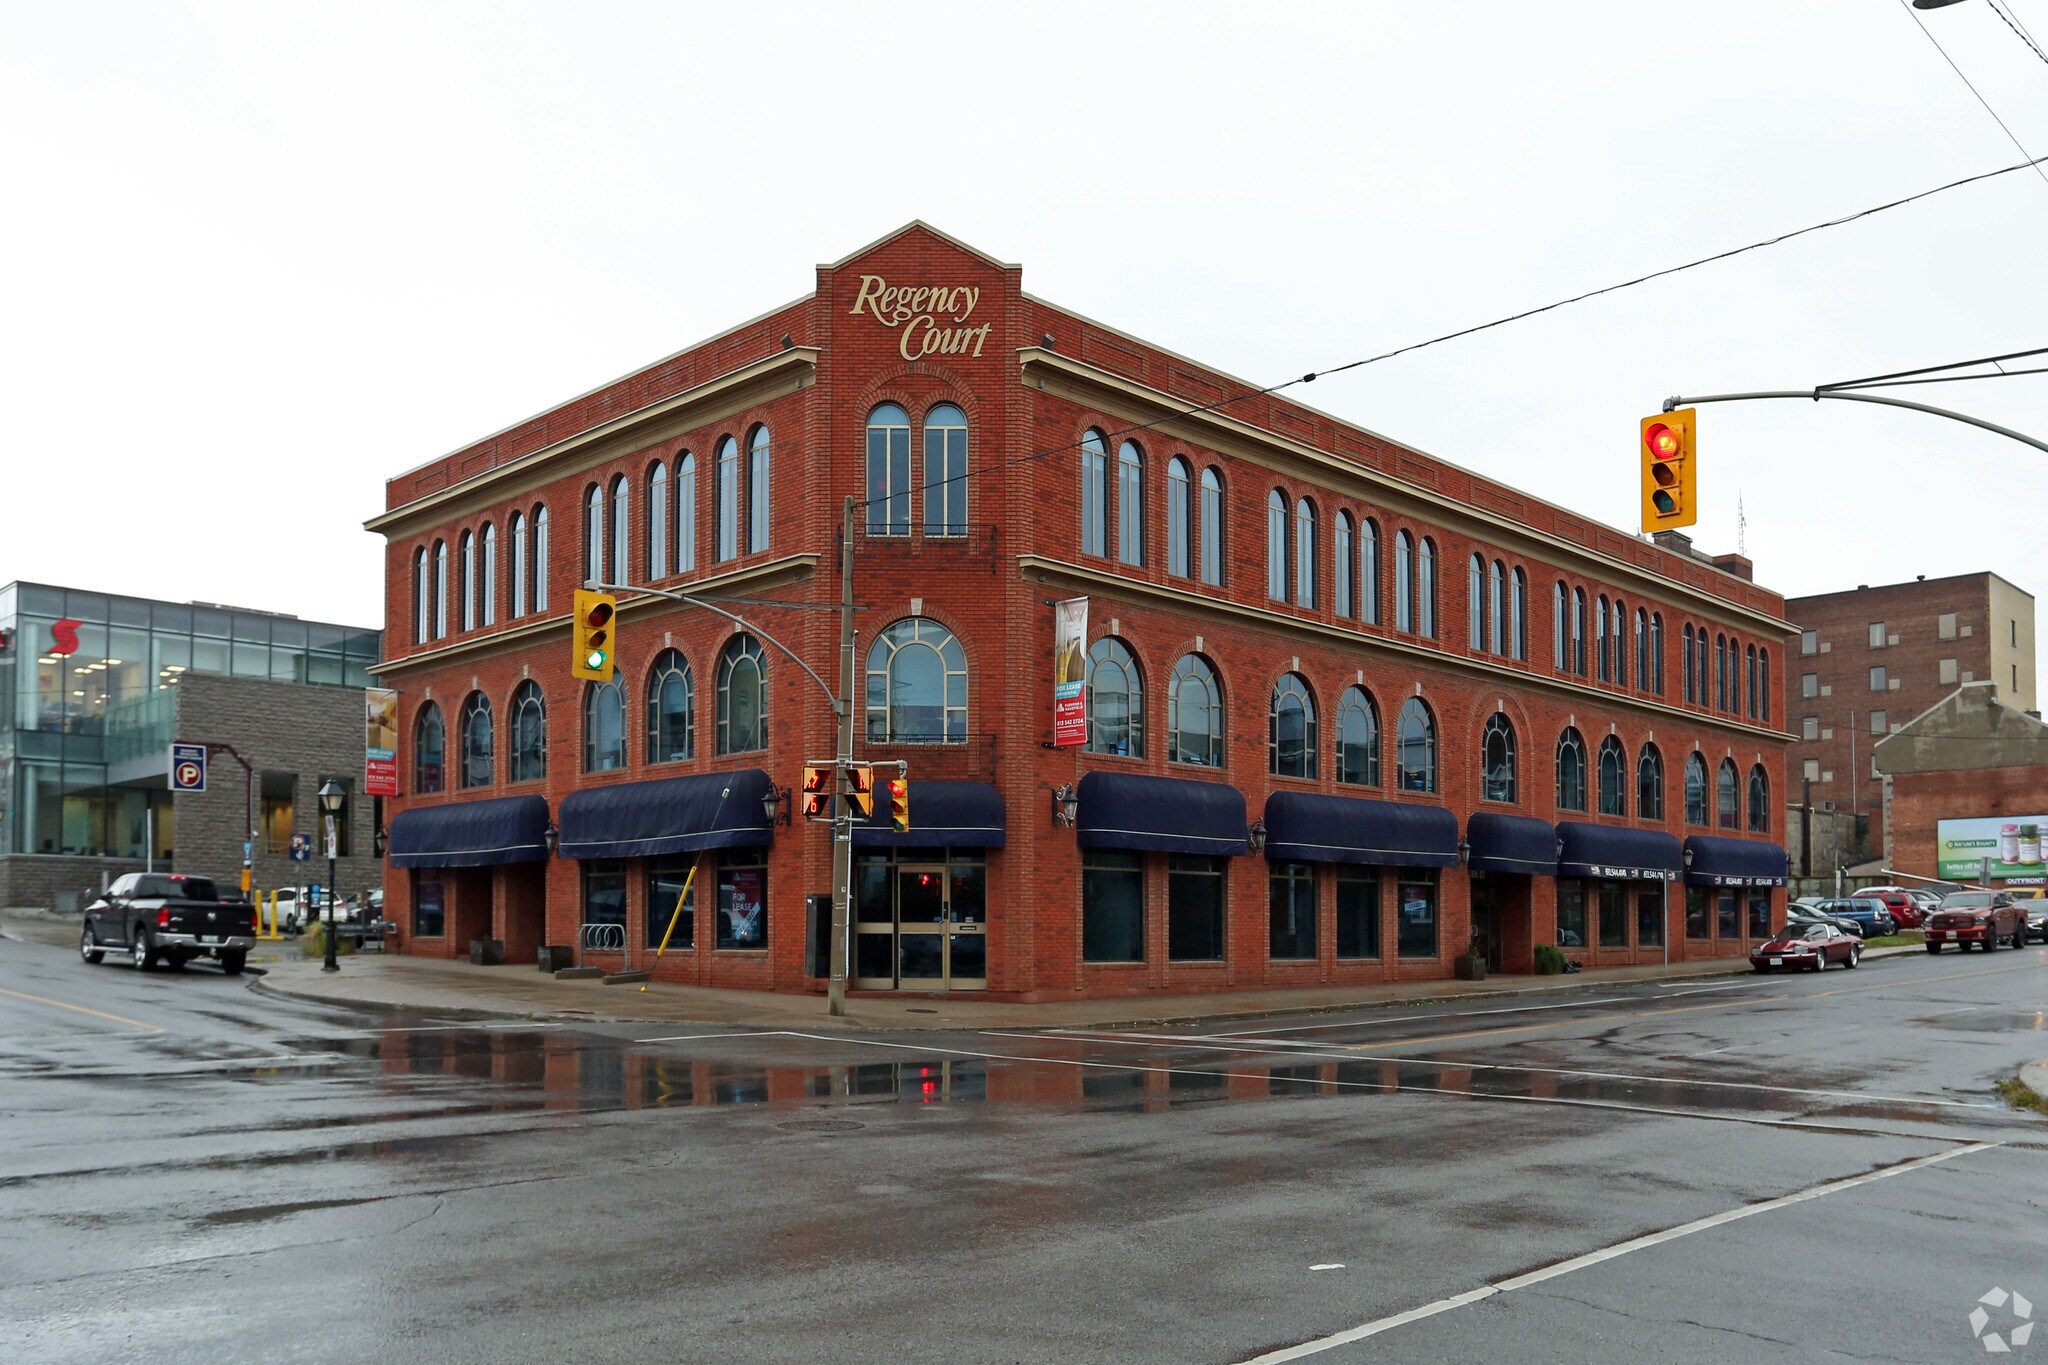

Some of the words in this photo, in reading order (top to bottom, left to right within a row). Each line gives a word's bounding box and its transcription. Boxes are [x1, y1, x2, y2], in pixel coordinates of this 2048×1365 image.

[849, 275, 980, 327] Regency
[899, 315, 993, 361] Court
[732, 893, 746, 901] FOR
[732, 902, 752, 911] LEASE
